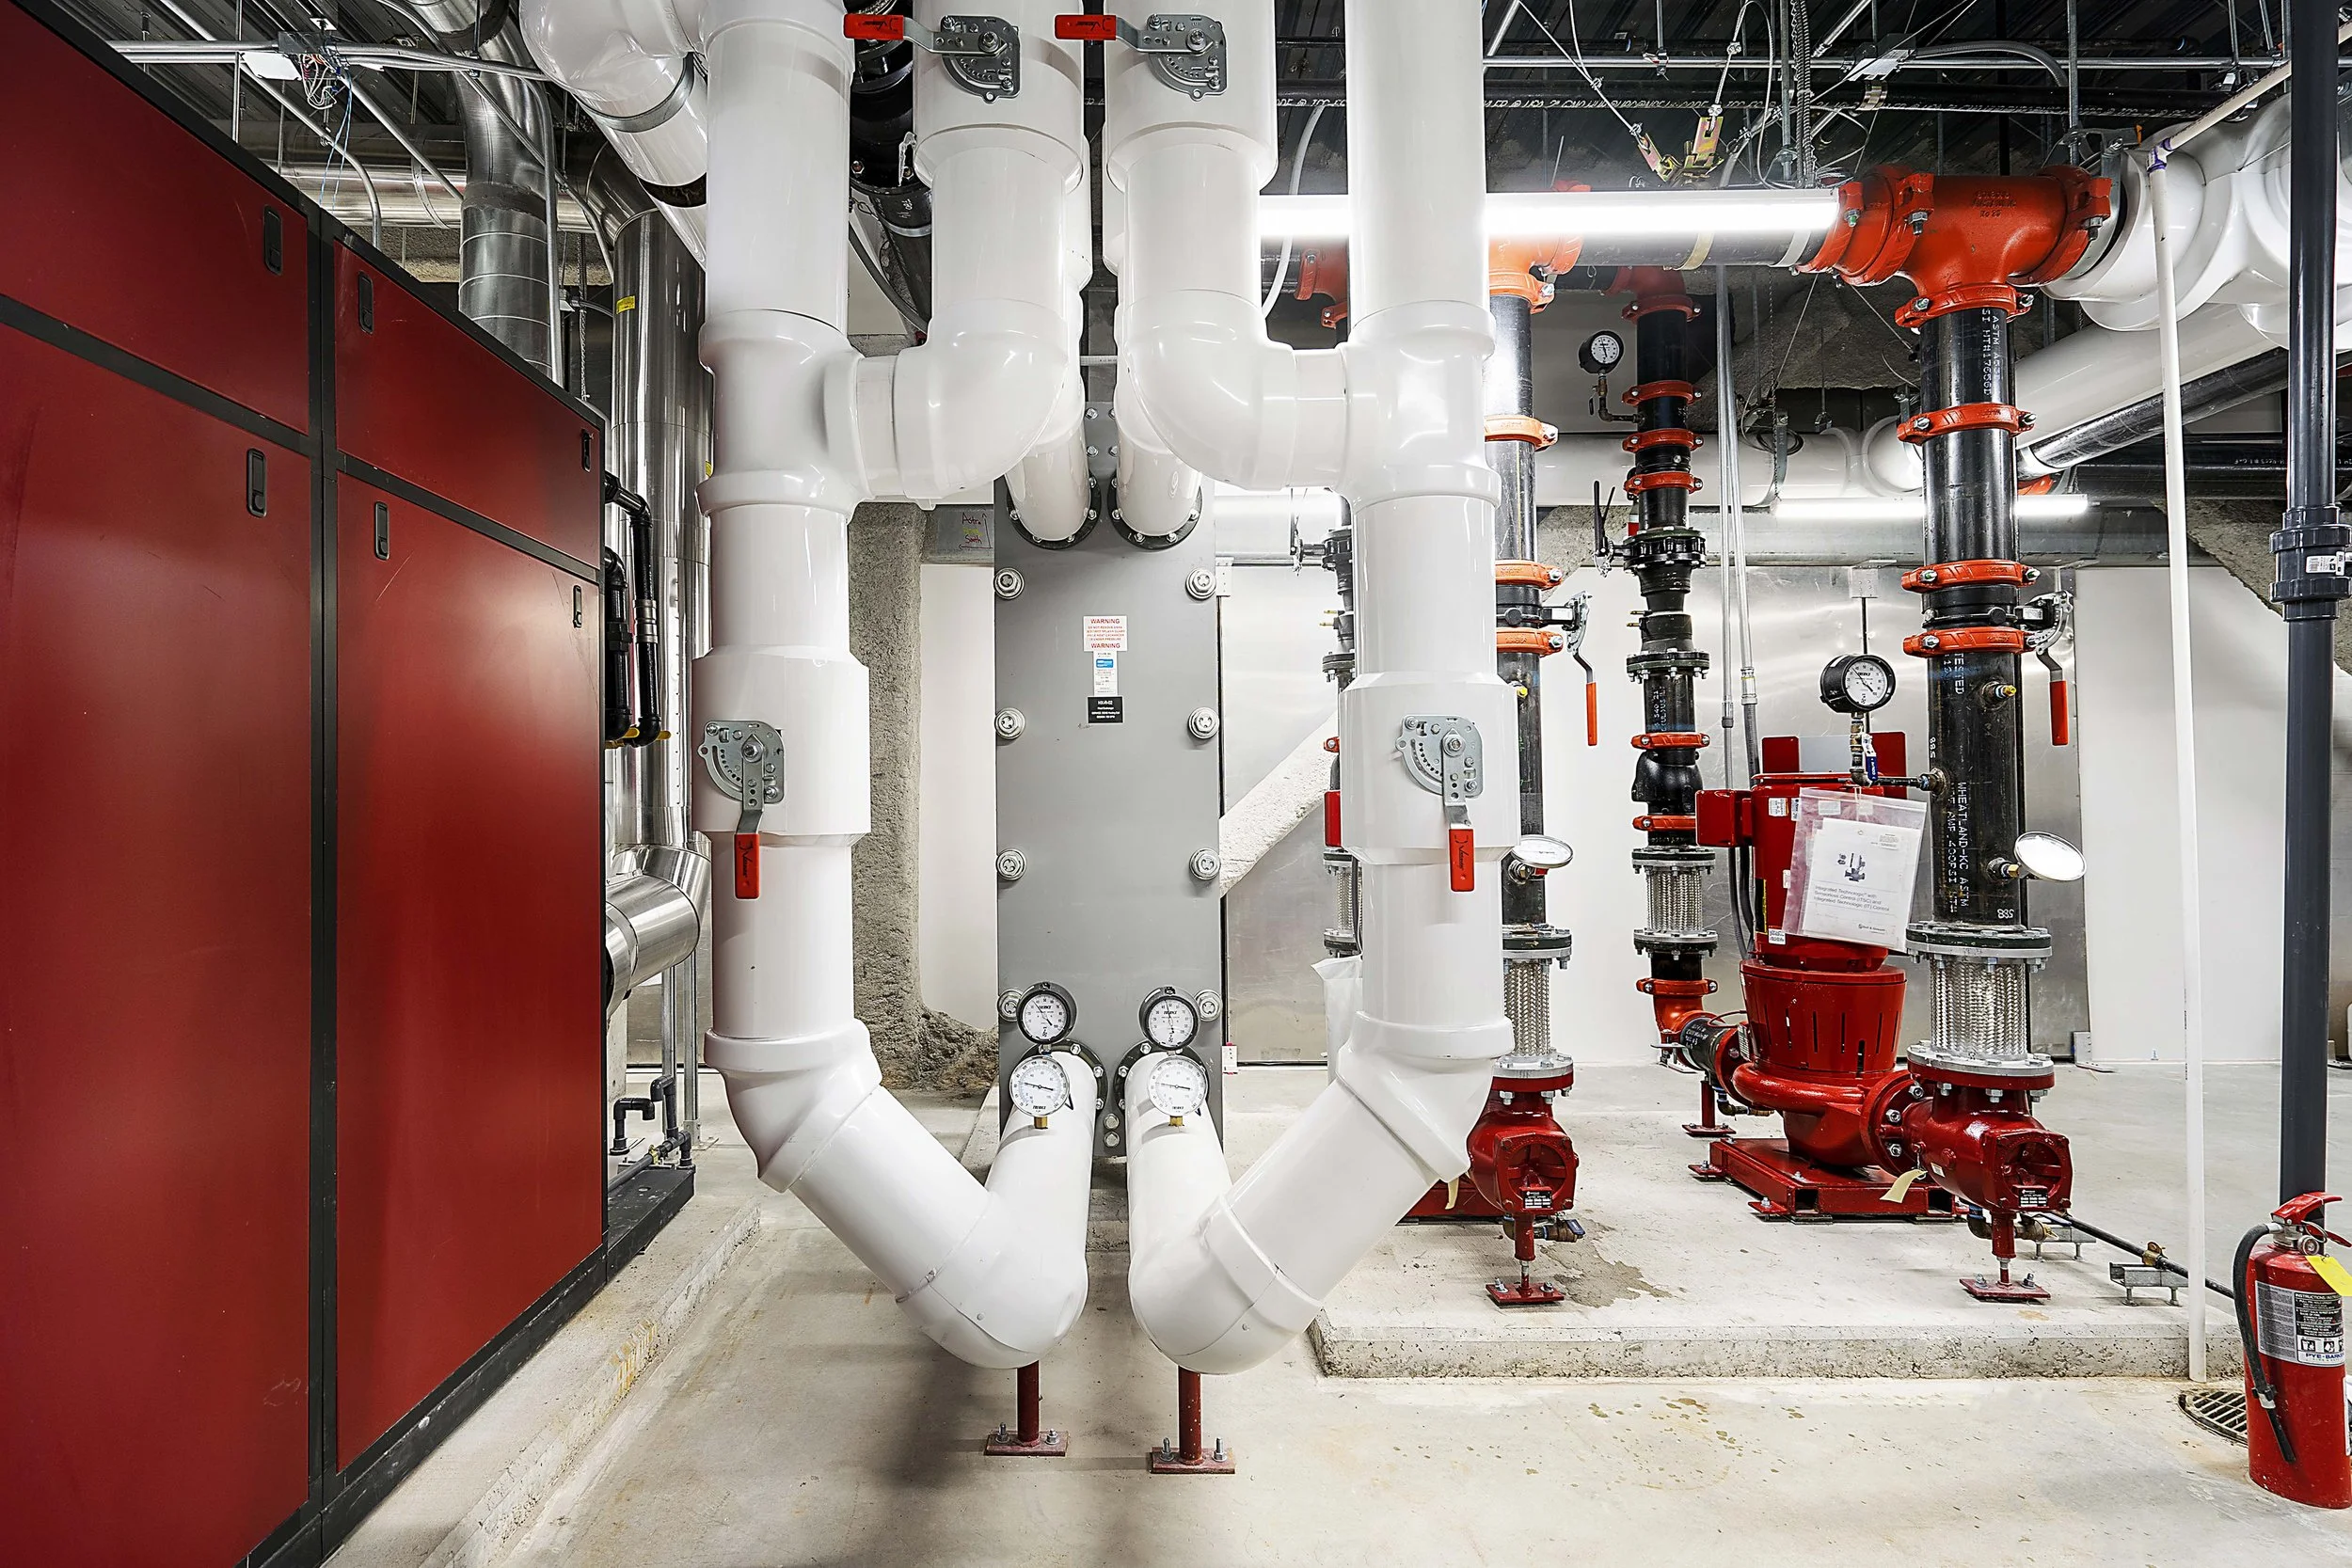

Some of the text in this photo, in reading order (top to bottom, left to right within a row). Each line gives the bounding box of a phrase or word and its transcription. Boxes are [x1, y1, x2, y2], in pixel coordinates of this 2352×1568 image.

[1955, 653, 1965, 695] TESTED
[1957, 782, 1969, 907] WHEATLAND-KC ASTM
